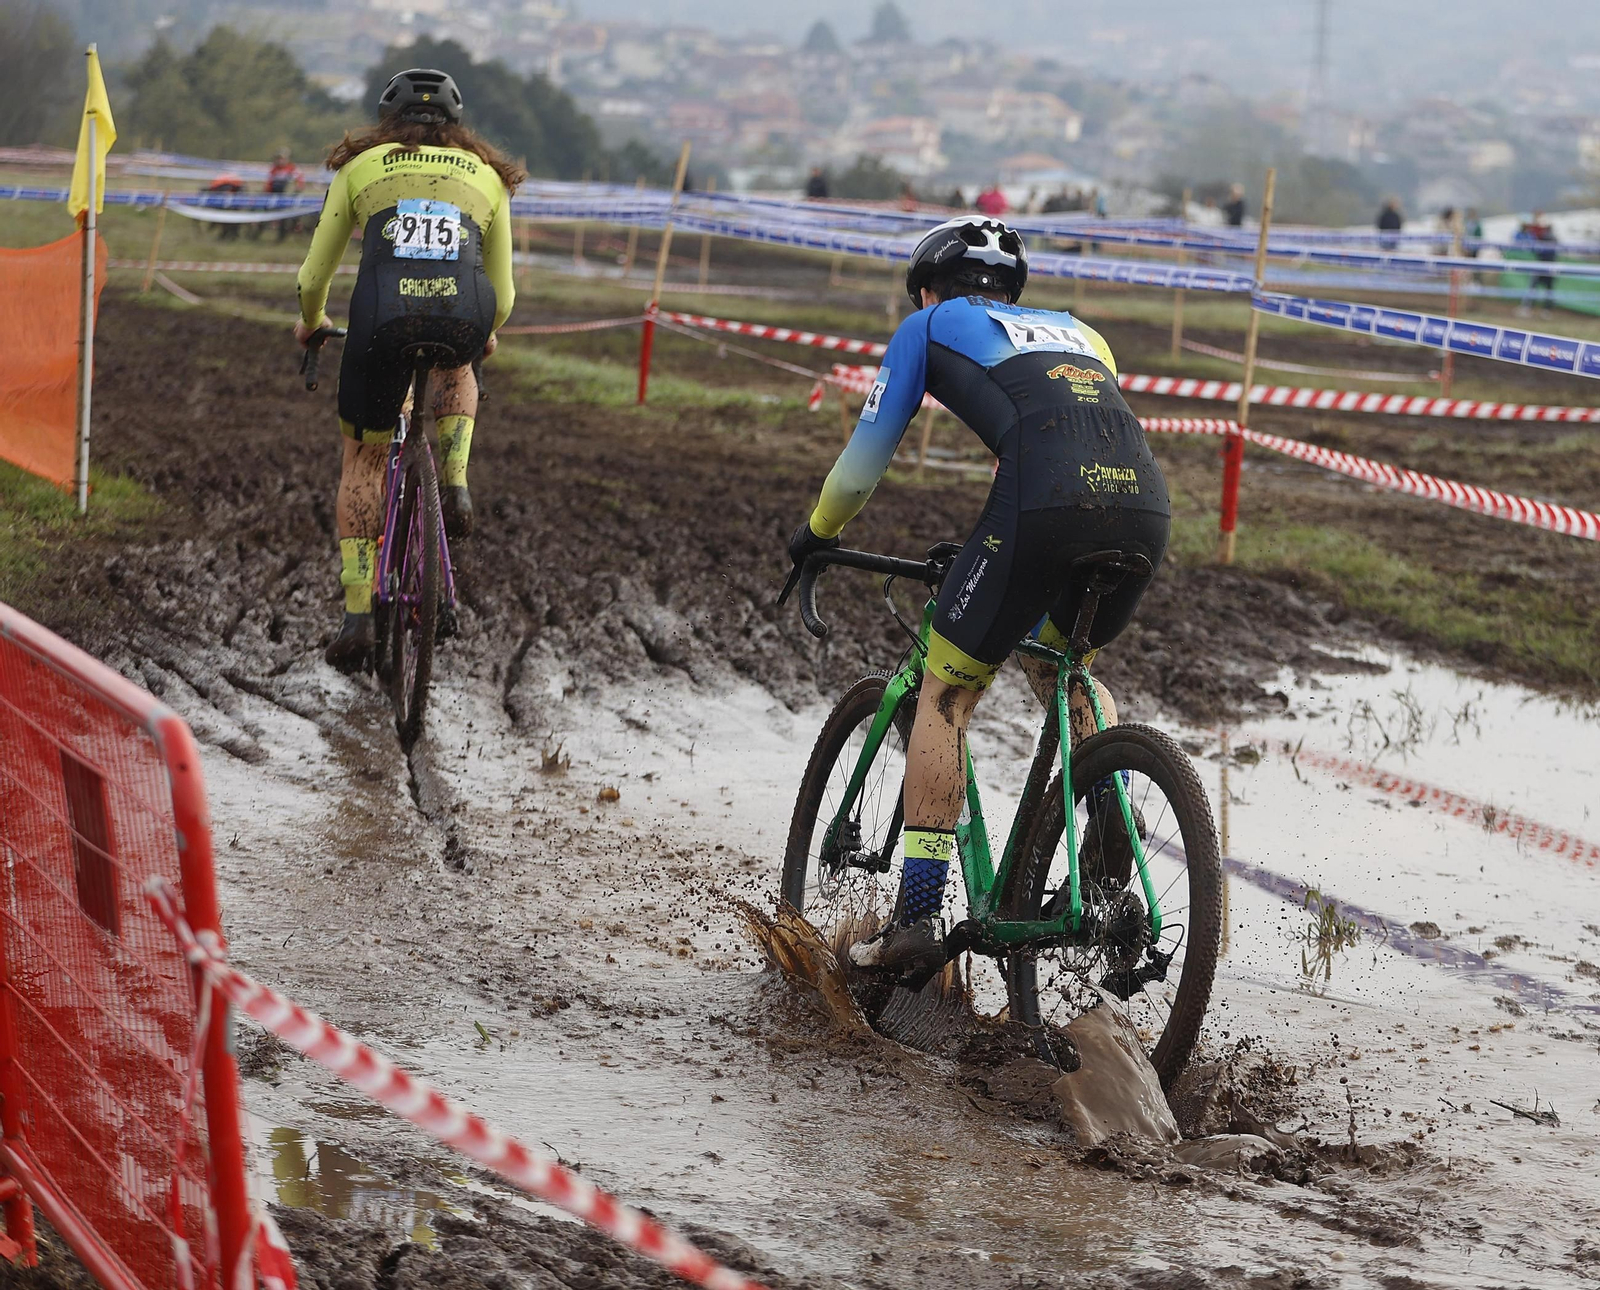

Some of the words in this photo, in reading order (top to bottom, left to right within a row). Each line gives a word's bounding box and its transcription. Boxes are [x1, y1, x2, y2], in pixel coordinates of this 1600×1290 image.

[402, 216, 453, 246] 915
[959, 593, 971, 610] Los
[965, 558, 988, 594] Milagros
